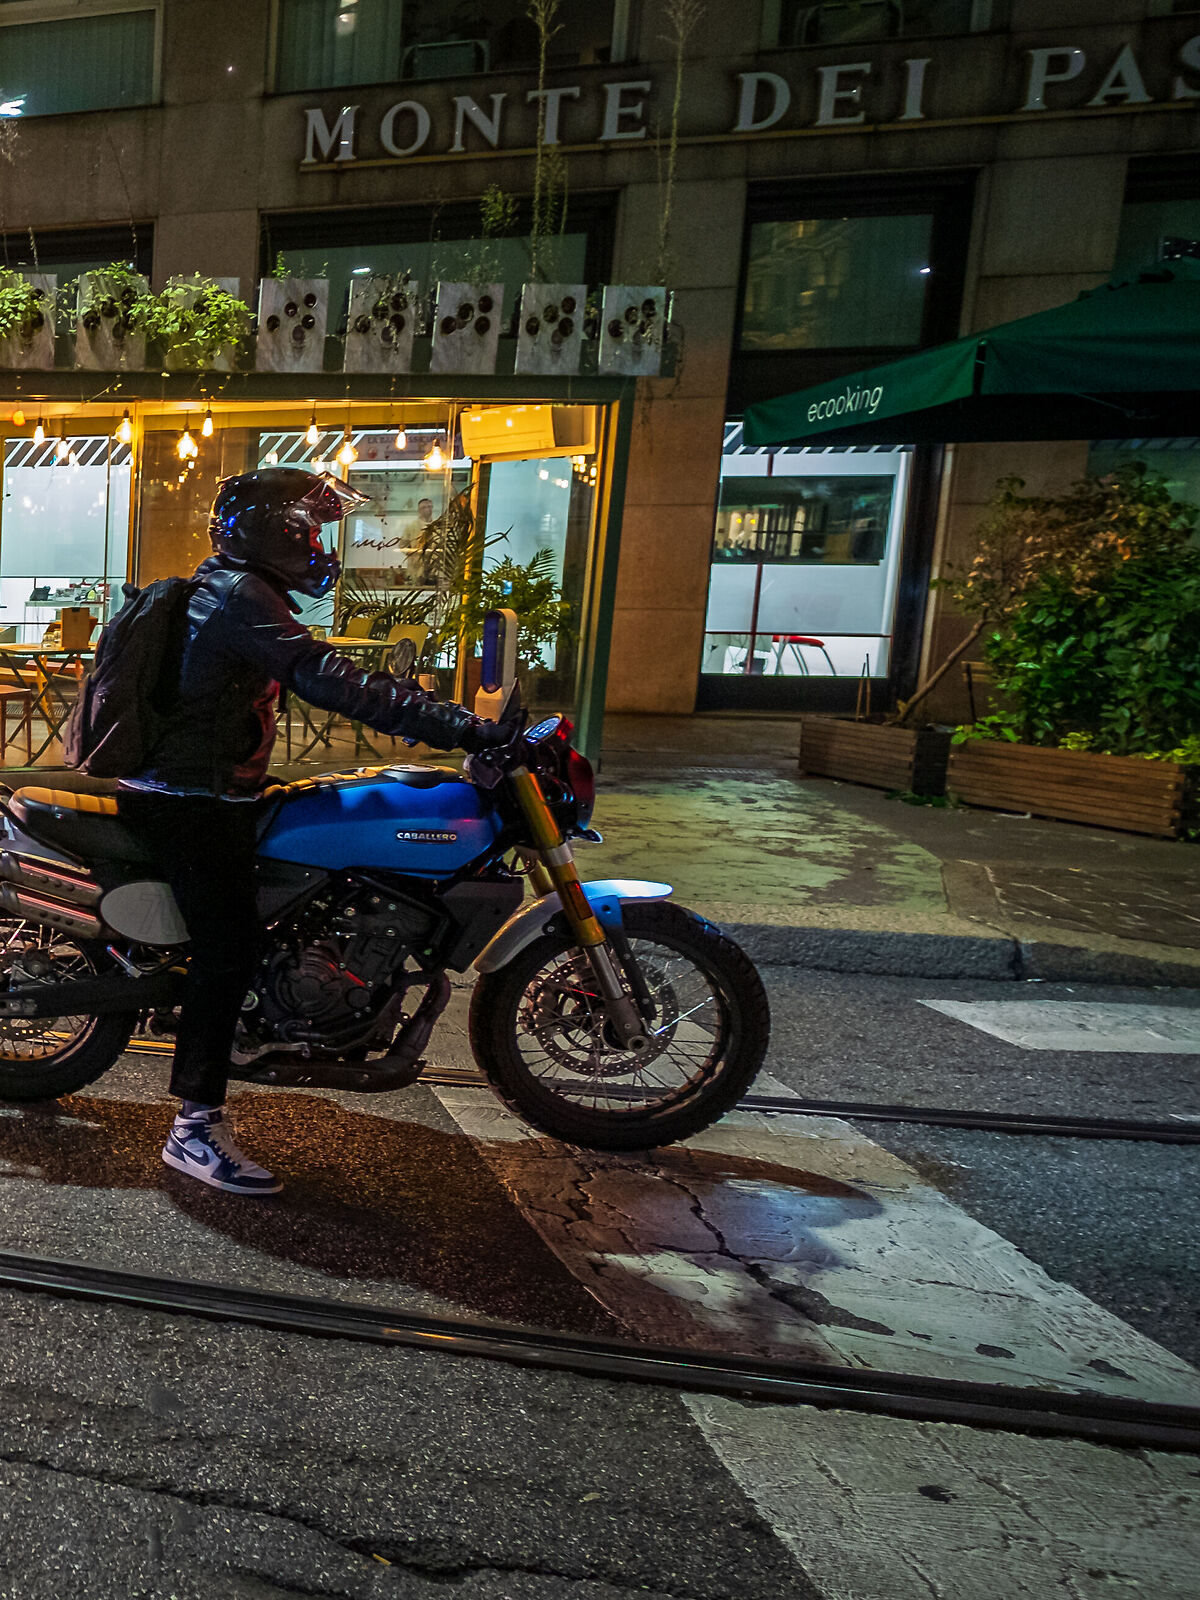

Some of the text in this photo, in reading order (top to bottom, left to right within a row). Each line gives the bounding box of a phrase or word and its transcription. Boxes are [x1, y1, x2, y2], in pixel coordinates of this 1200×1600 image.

[301, 80, 653, 165] MONTE
[731, 57, 932, 133] DEI
[807, 385, 884, 422] ecooking
[396, 831, 457, 841] CABALLERO
